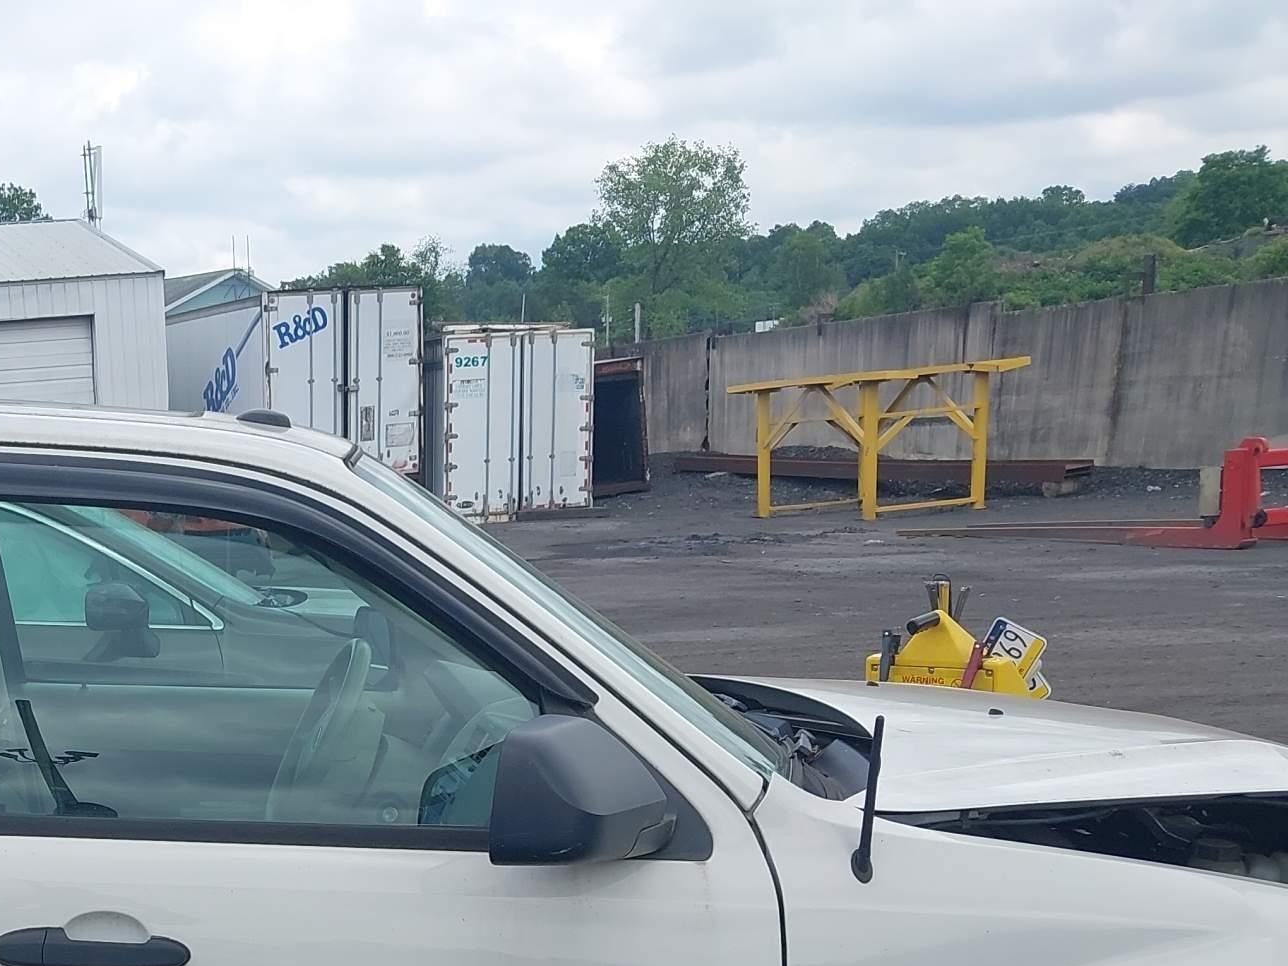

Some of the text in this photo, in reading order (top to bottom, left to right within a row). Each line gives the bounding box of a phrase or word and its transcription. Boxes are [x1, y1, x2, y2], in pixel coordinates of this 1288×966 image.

[273, 306, 328, 349] R&D
[203, 347, 236, 412] R&D
[455, 356, 488, 368] 9267
[992, 630, 1028, 667] 69
[902, 675, 945, 685] WARNING
